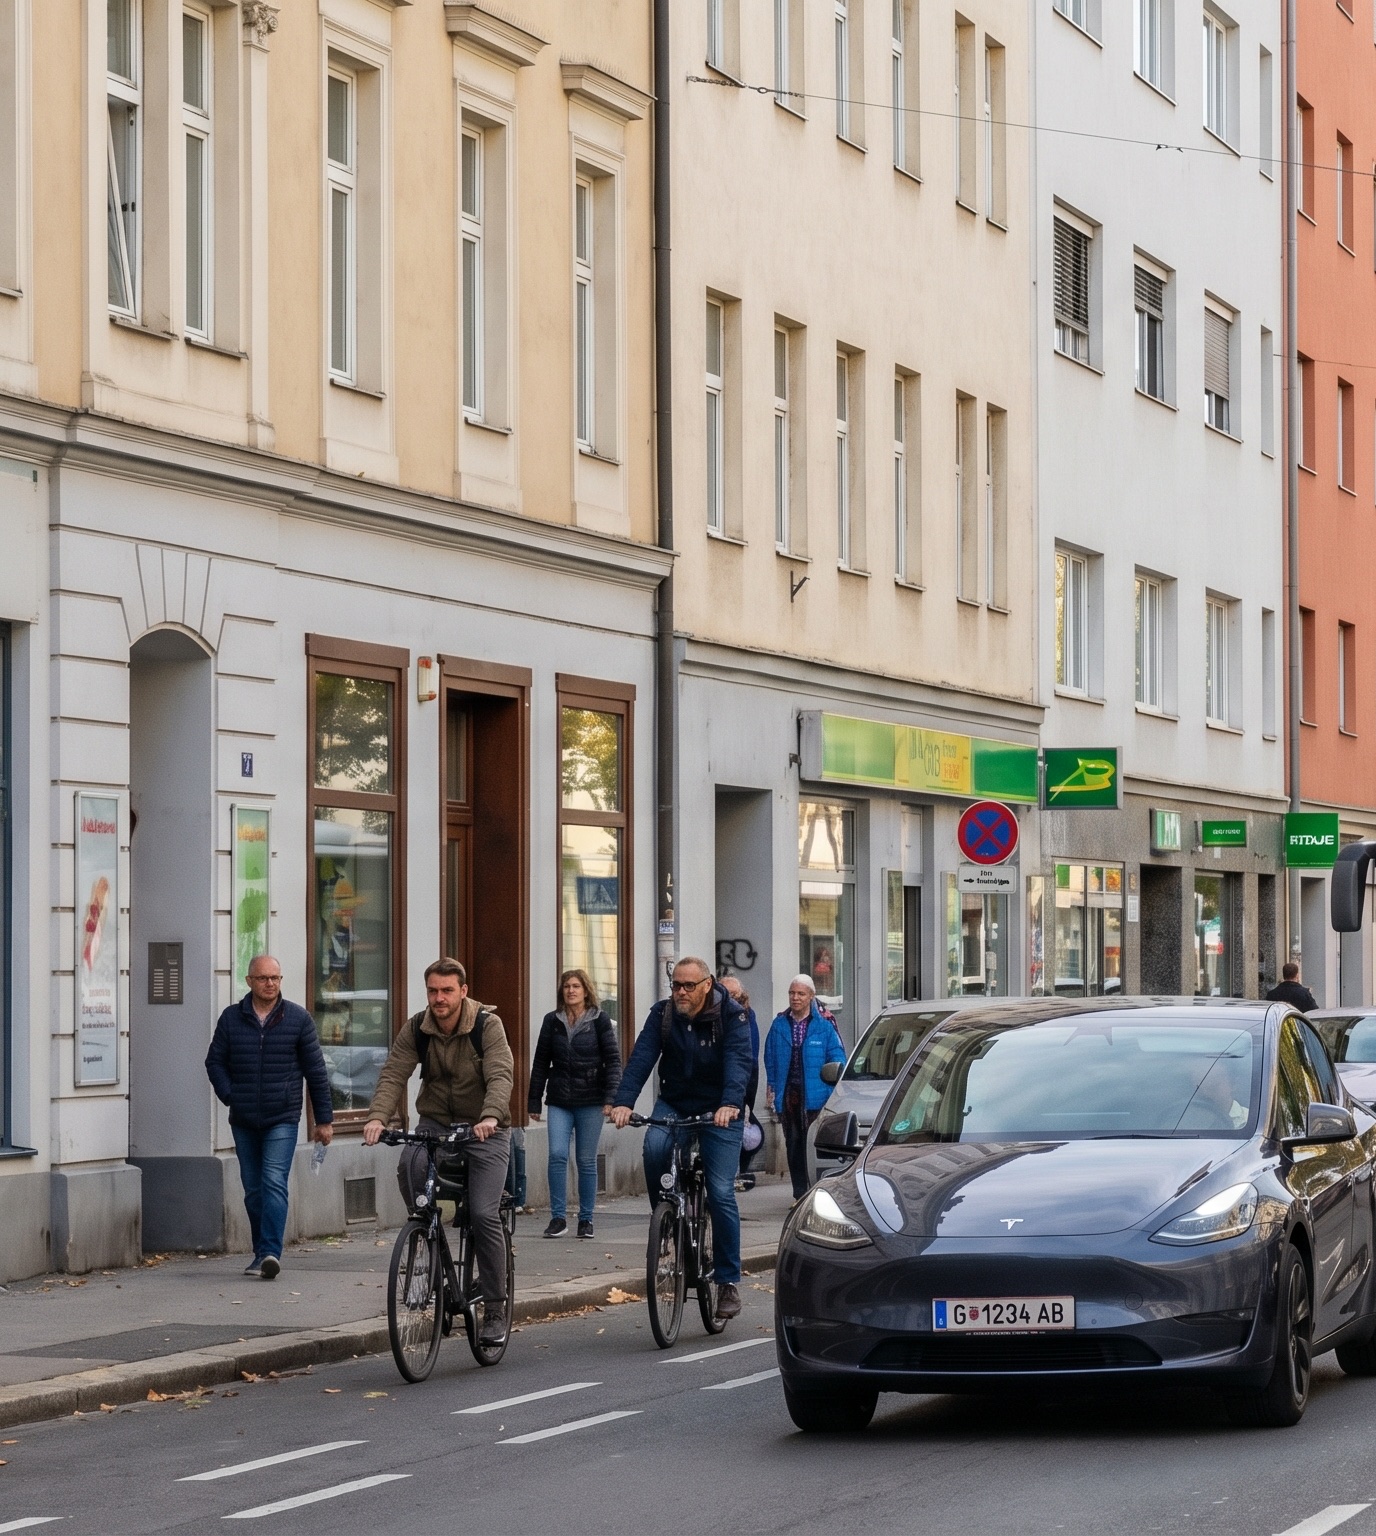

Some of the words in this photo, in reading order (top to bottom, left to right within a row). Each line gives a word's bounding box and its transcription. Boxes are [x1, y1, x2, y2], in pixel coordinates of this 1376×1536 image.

[953, 1304, 966, 1325] G
[981, 1303, 1031, 1325] 1234
[1037, 1302, 1064, 1324] AB
